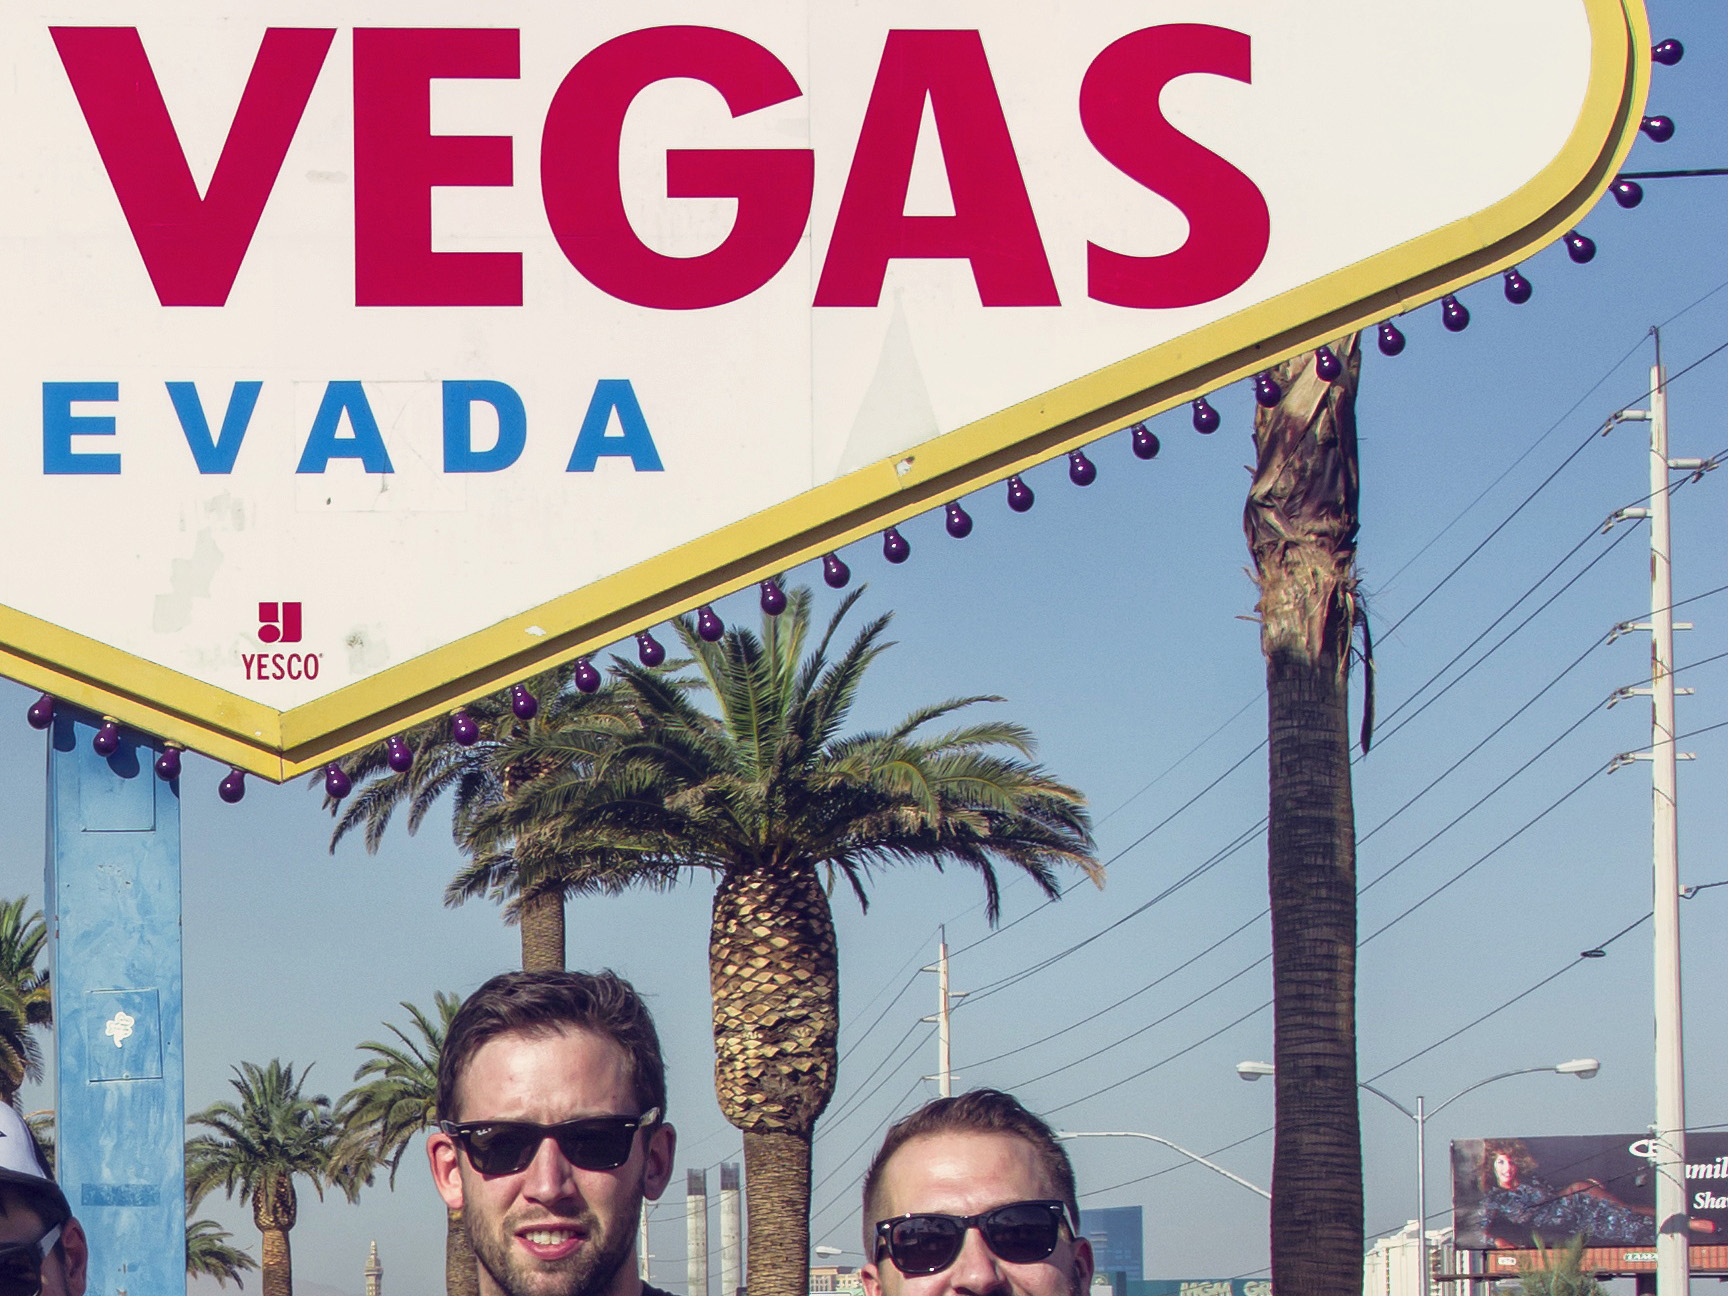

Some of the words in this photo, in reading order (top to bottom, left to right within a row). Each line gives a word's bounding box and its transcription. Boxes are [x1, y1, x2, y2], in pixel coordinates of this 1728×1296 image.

[48, 23, 1270, 311] VEGAS
[241, 653, 319, 681] YESCO
[1693, 1191, 1728, 1209] Sha
